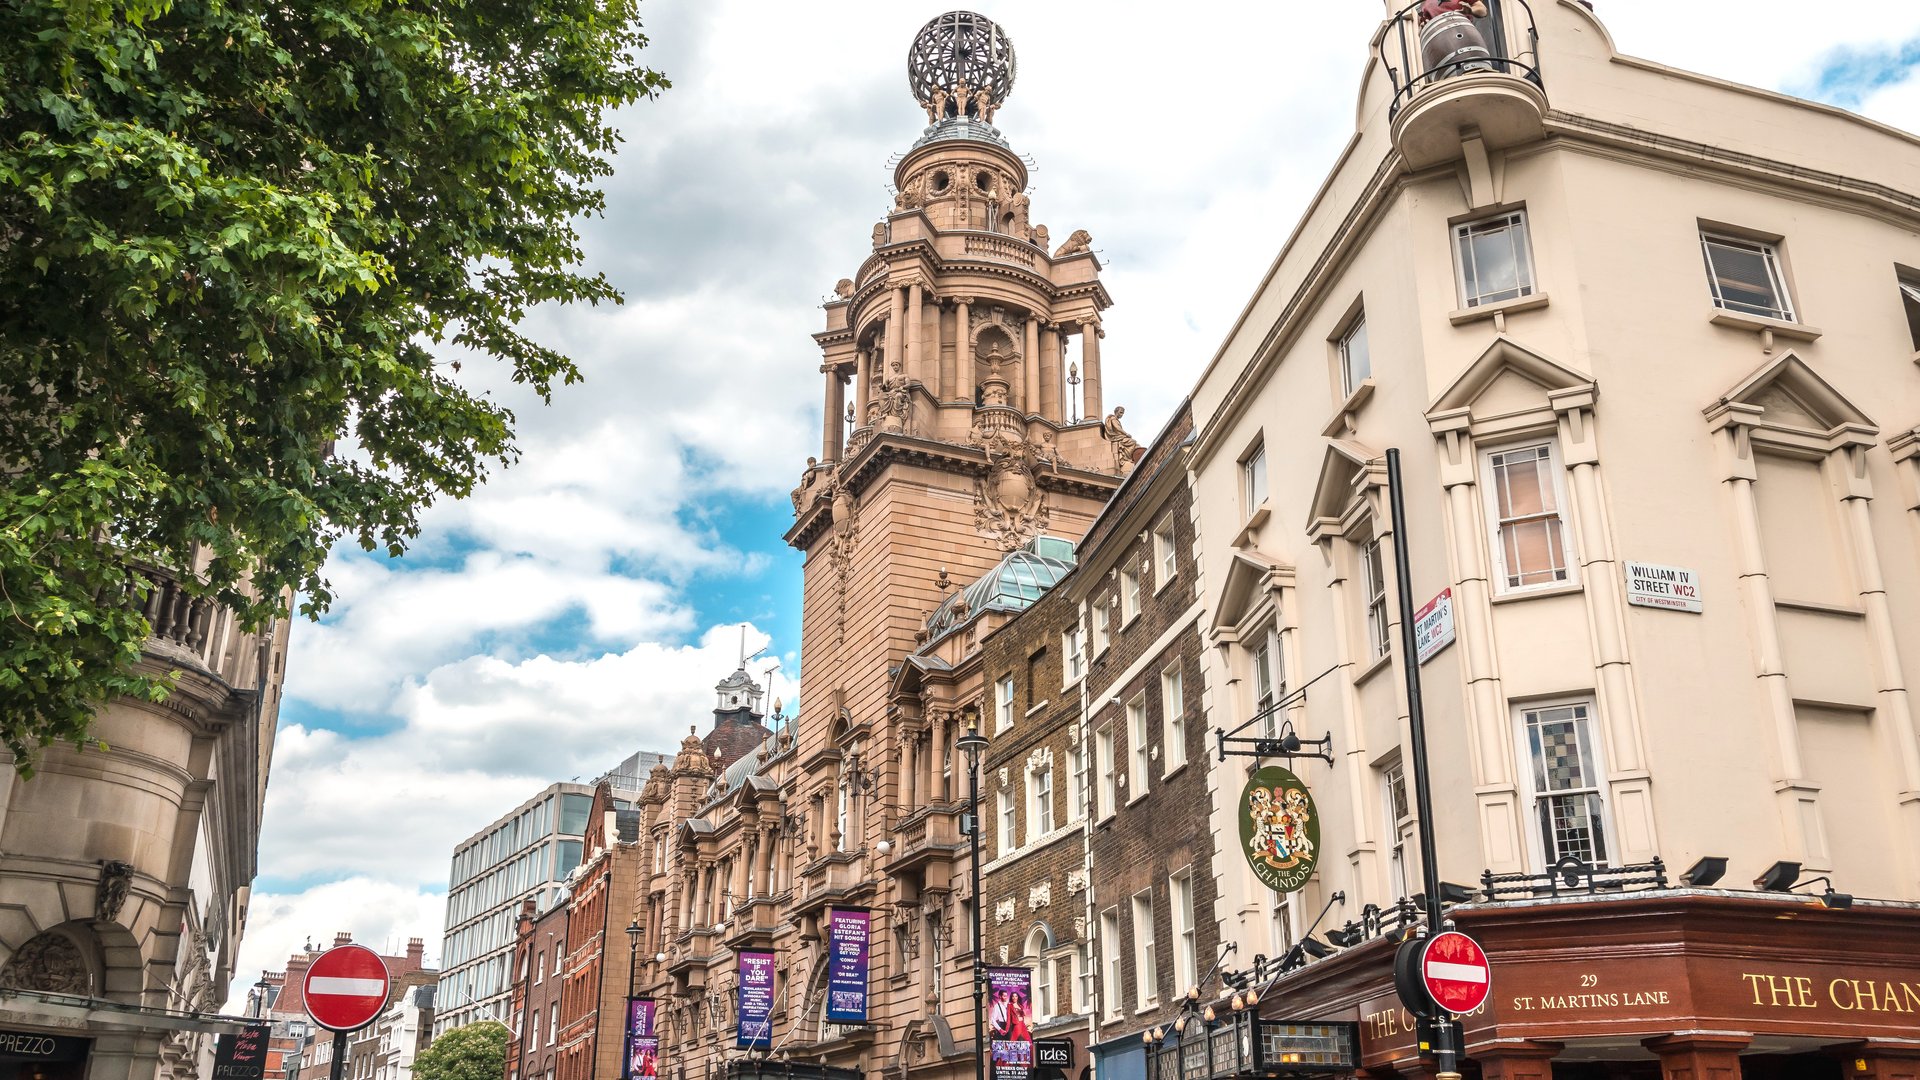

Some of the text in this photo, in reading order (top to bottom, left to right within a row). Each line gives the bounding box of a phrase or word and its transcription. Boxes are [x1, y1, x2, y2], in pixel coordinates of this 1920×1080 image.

[1631, 566, 1688, 582] WILLIAM IV
[1634, 580, 1695, 597] STREET WC2
[1654, 598, 1686, 607] WESTMINSTER
[1417, 624, 1422, 636] ST
[1424, 605, 1447, 630] MARTIN'S
[1418, 623, 1442, 649] LANE WC2
[1256, 862, 1310, 888] CHANDOS
[1580, 975, 1598, 987] 29
[1514, 992, 1670, 1010] ST. MARTINS LANE
[1742, 973, 1920, 1012] THE CHAN
[1367, 1008, 1398, 1040] THE
[0, 1034, 55, 1055] PREZZO
[233, 1051, 255, 1061] Vino
[1040, 1047, 1067, 1060] notes
[217, 1065, 260, 1077] PREZZO
